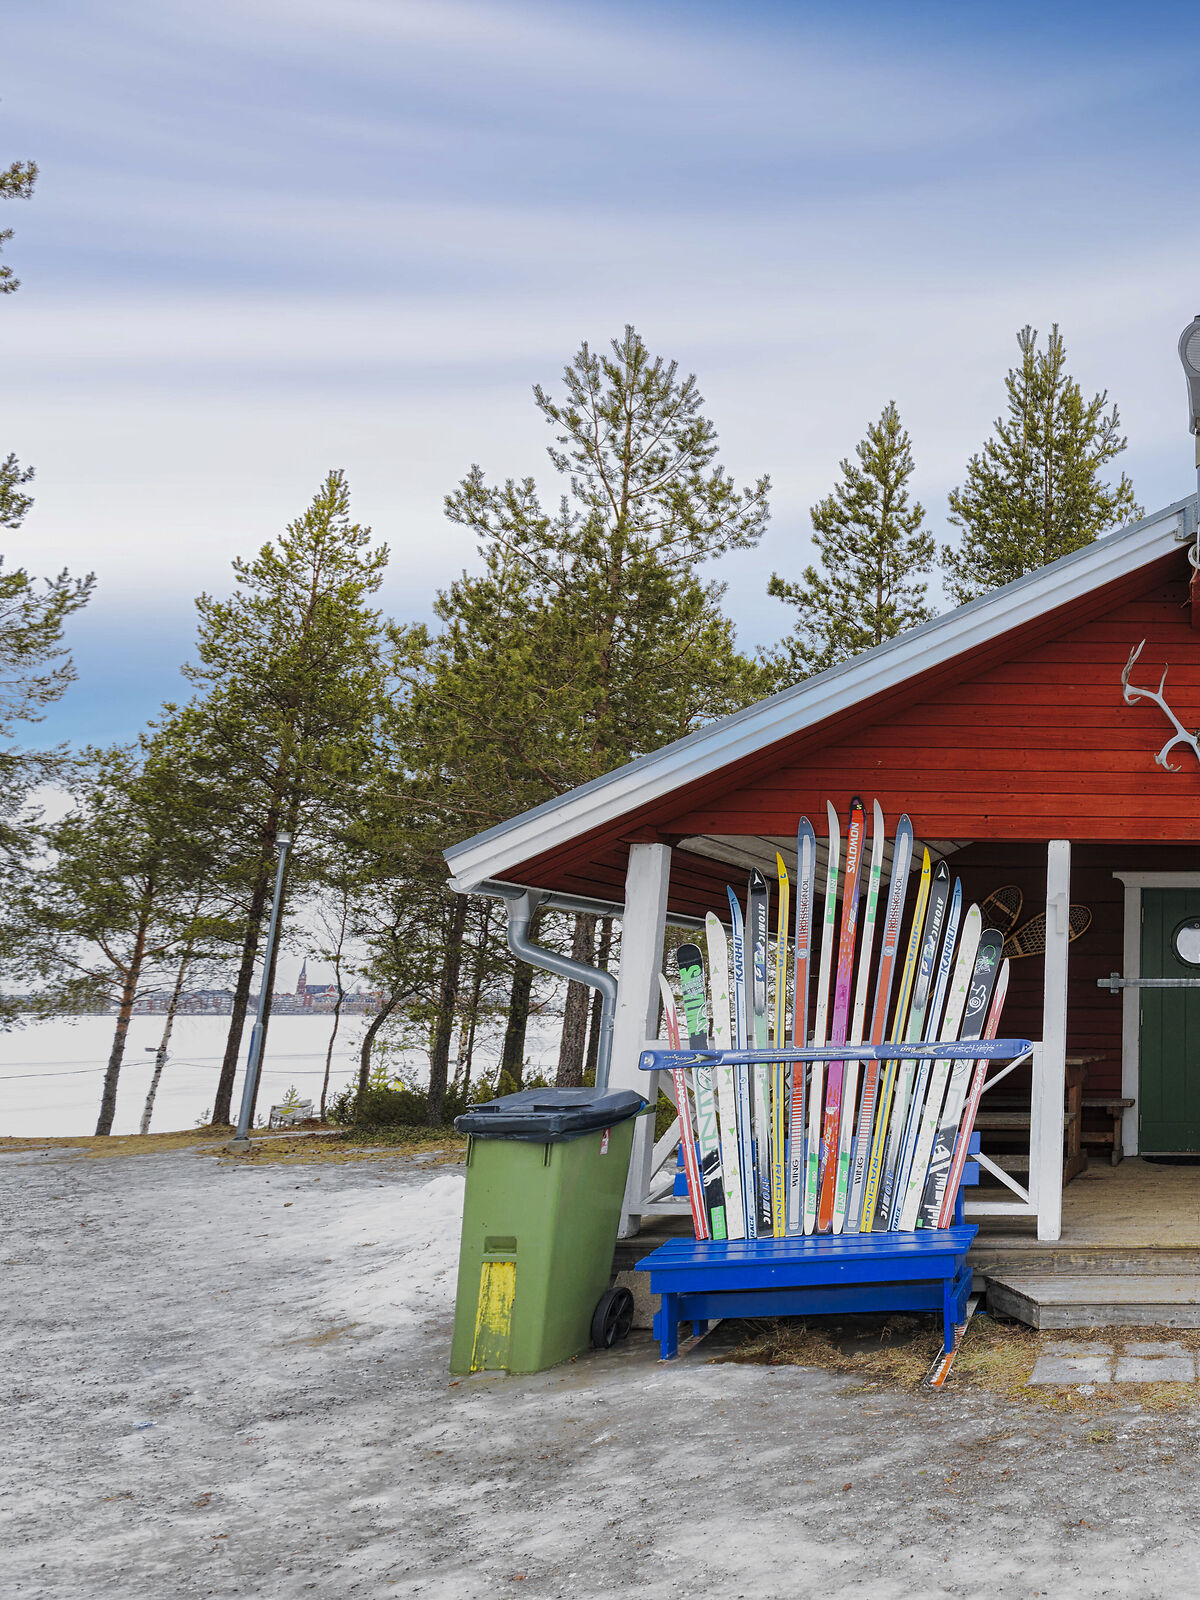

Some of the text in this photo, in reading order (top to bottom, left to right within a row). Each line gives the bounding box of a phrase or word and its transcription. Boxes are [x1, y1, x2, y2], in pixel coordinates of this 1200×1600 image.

[848, 822, 859, 874] SALOMON
[758, 903, 766, 942] ATOMIC
[931, 896, 944, 937] ATOMIC
[735, 935, 744, 983] KARHU
[941, 925, 956, 975] KARHU
[946, 1044, 995, 1055] FISCHER
[855, 1157, 863, 1184] WING
[865, 1158, 878, 1223] RACING
[762, 1177, 771, 1225] ATOMIC
[881, 1170, 894, 1220] ATOMIC
[893, 1207, 901, 1230] RACE
